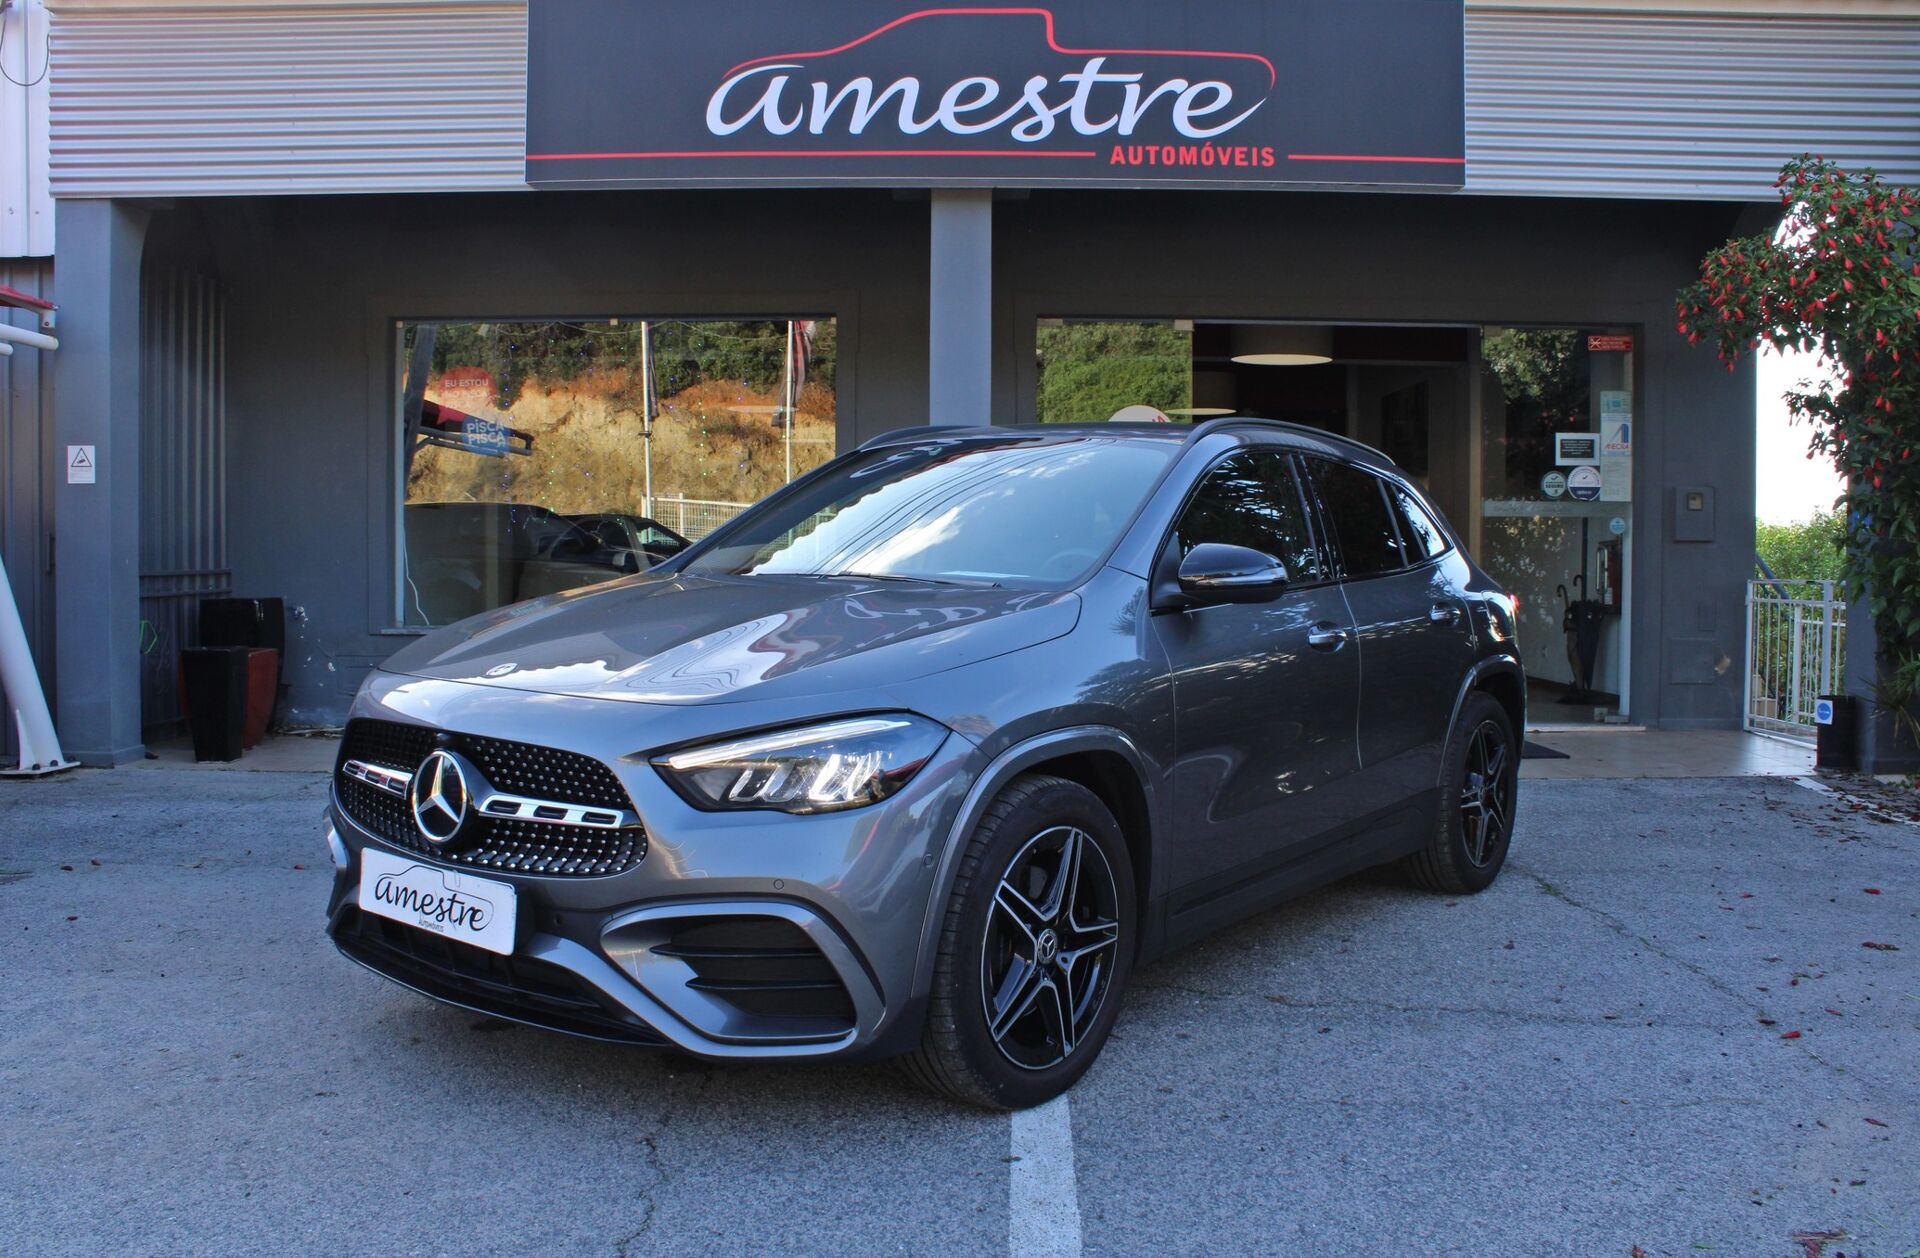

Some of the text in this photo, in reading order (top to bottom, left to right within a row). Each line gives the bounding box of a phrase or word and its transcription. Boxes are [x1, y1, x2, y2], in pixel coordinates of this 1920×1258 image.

[706, 57, 1267, 142] amestre
[1110, 142, 1275, 167] AUTOMÓVEIS
[445, 379, 489, 388] EU ESTOU
[375, 876, 493, 931] amestre
